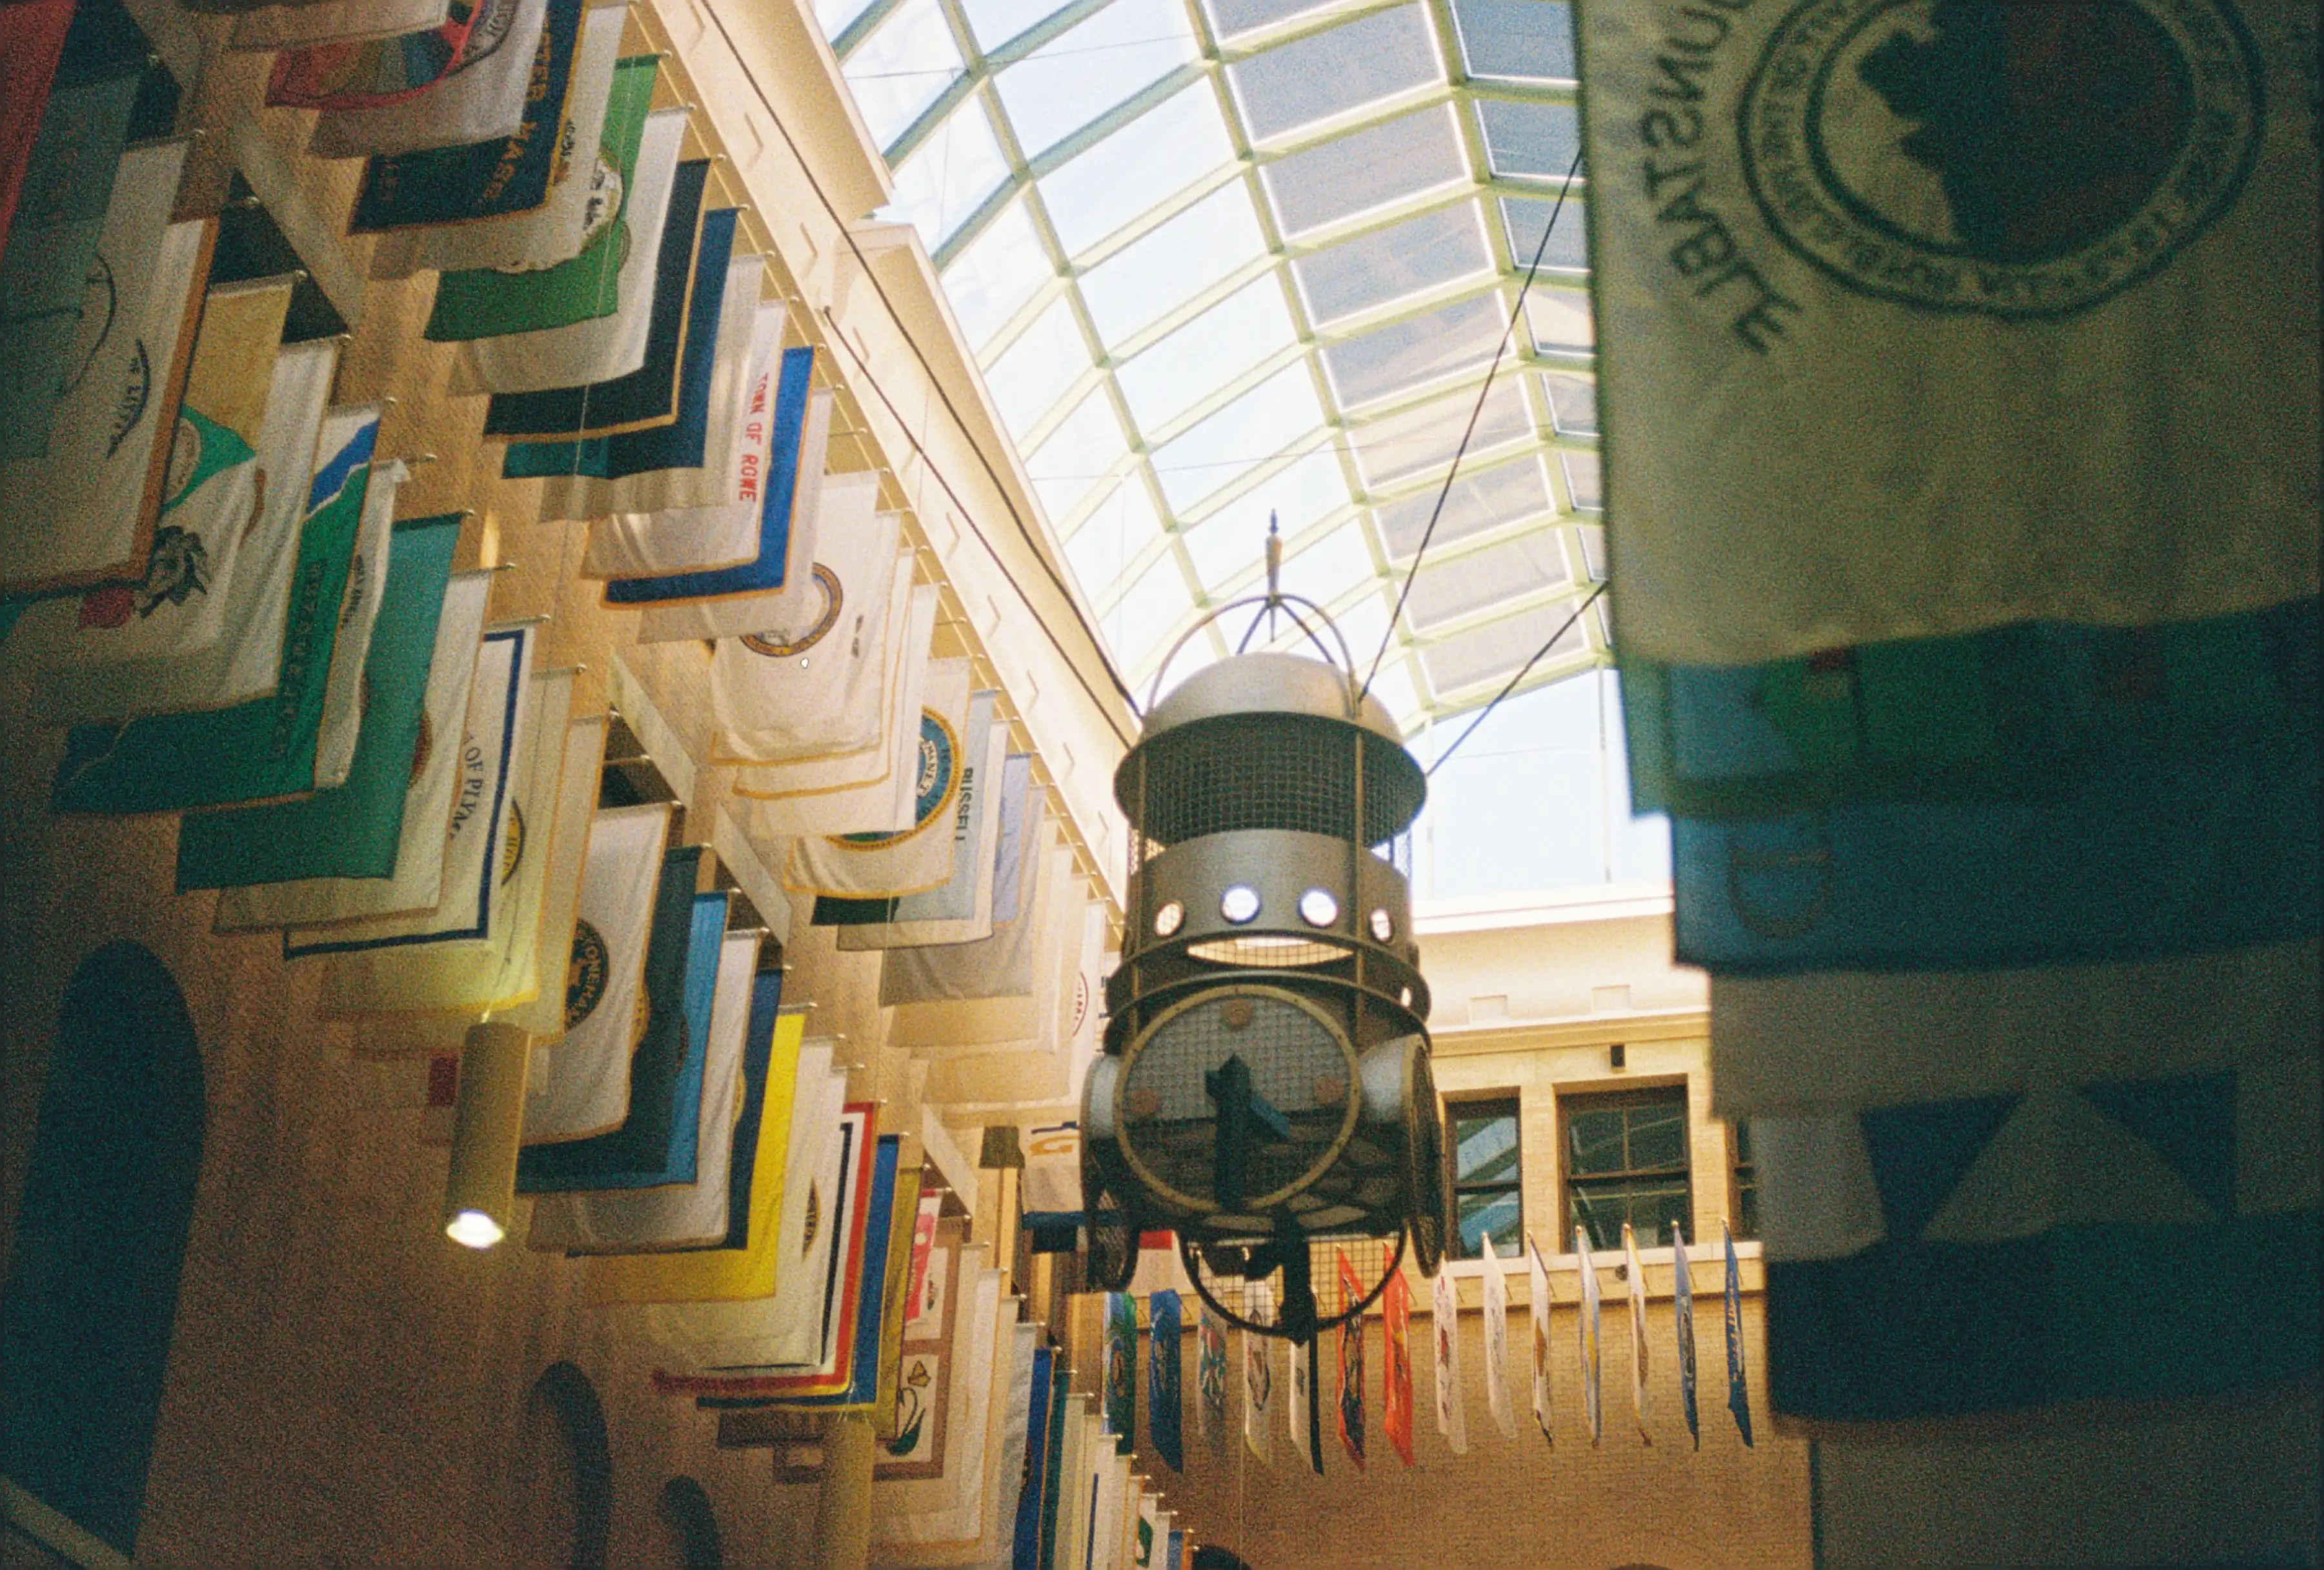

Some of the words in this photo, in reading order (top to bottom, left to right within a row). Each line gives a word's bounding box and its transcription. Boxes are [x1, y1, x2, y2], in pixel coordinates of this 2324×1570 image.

[749, 372, 769, 415] TOWN
[746, 422, 762, 445] OF
[739, 453, 760, 503] ROWE
[464, 746, 484, 772] OF
